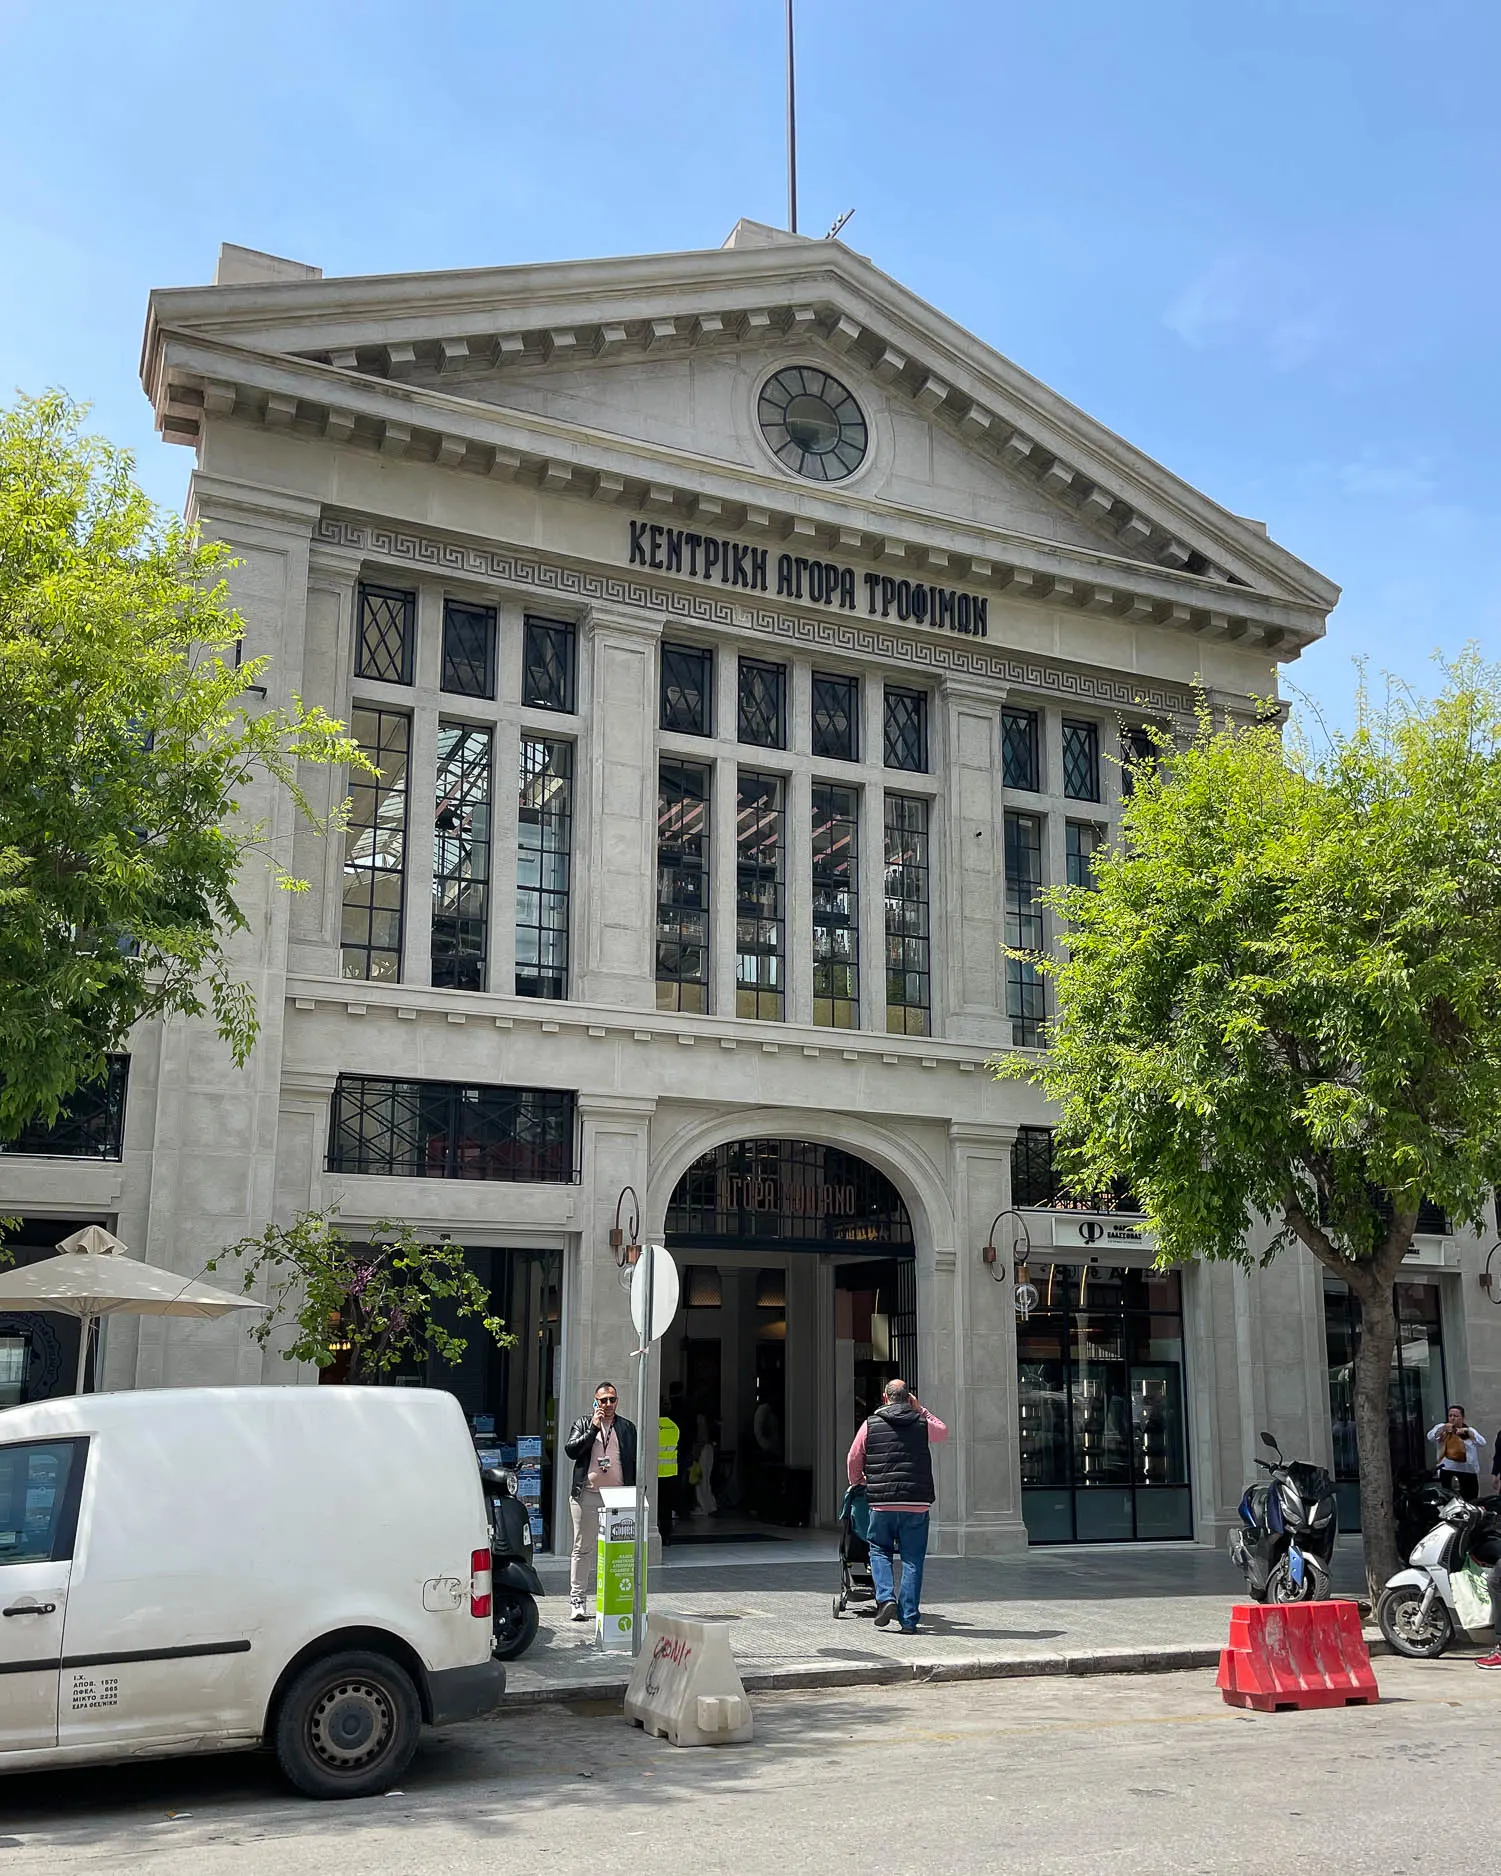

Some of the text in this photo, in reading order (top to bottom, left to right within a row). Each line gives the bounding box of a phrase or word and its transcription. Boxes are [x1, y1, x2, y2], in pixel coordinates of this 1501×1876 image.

[628, 520, 989, 637] ΚΕΝΤΡΙΚΗ ΑΓΟΡΑ ΤΡΟΦΙΜΩΝ
